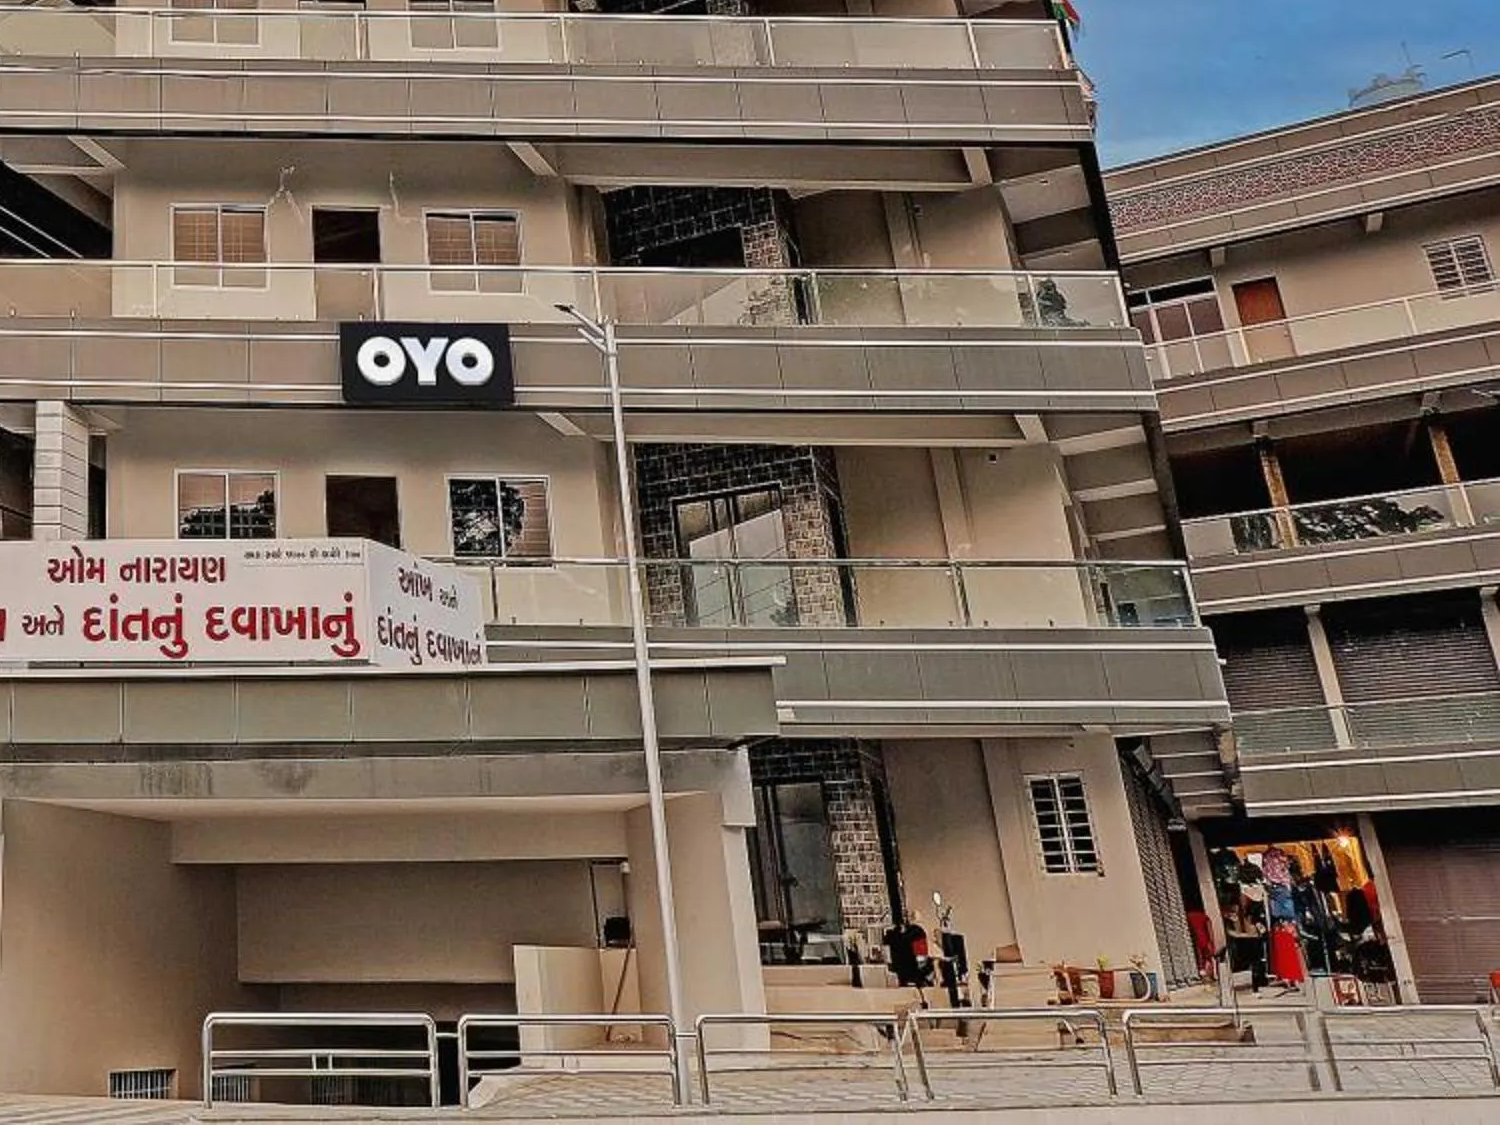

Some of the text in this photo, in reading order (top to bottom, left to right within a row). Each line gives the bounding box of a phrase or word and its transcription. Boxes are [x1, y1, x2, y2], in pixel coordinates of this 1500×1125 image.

[357, 336, 494, 386] OYO
[48, 545, 226, 584] ઓમ નારાયણ
[398, 561, 433, 602] આંખ
[21, 604, 64, 636] અને
[83, 593, 188, 659] દાંતનું
[205, 592, 360, 658] દવાખાનું
[377, 606, 423, 665] દાંતનું
